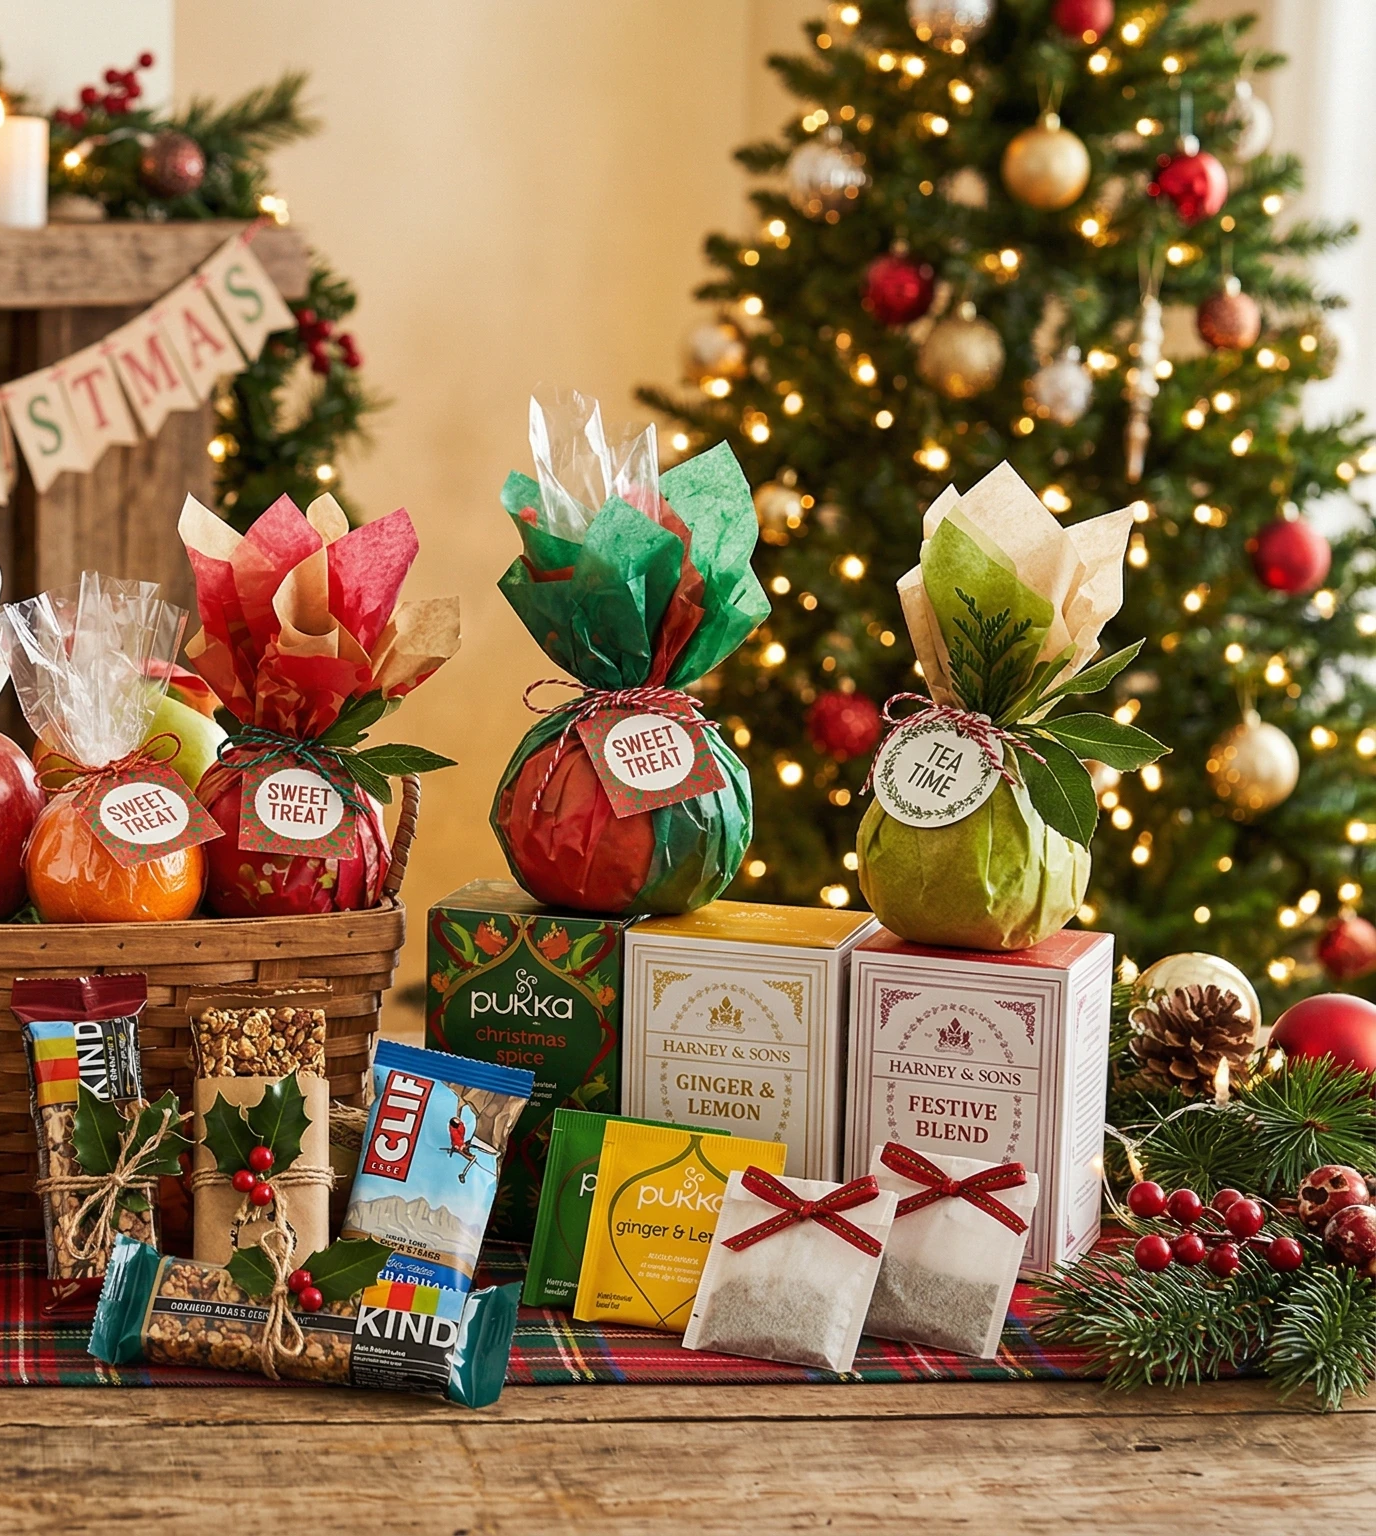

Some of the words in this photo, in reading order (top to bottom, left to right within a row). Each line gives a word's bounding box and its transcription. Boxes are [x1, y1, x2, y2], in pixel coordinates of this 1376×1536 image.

[612, 725, 676, 758] SWEET
[622, 747, 682, 778] TREAT
[927, 742, 964, 774] TEA
[907, 763, 956, 798] TIME
[106, 789, 167, 822] SWEET
[267, 783, 332, 806] SWEET
[120, 806, 178, 836] TREAT
[269, 802, 328, 826] TREAT
[470, 972, 573, 1020] pukka
[475, 1025, 567, 1048] christmas
[73, 1021, 110, 1099] KIND
[496, 1049, 545, 1066] spice
[662, 1039, 728, 1058] HARNEY
[731, 1046, 745, 1059] &
[749, 1047, 791, 1063] SONS
[676, 1073, 755, 1097] GINGER
[759, 1082, 775, 1099] &
[889, 1060, 956, 1080] HARNEY
[960, 1067, 974, 1081] &
[978, 1069, 1022, 1086] SONS
[374, 1074, 427, 1162] CLIF
[687, 1098, 761, 1121] LEMON
[908, 1094, 998, 1121] FESTIVE
[915, 1119, 989, 1144] BLEND
[616, 1218, 669, 1240] ginger
[672, 1225, 685, 1239] &
[355, 1305, 459, 1349] KIND
